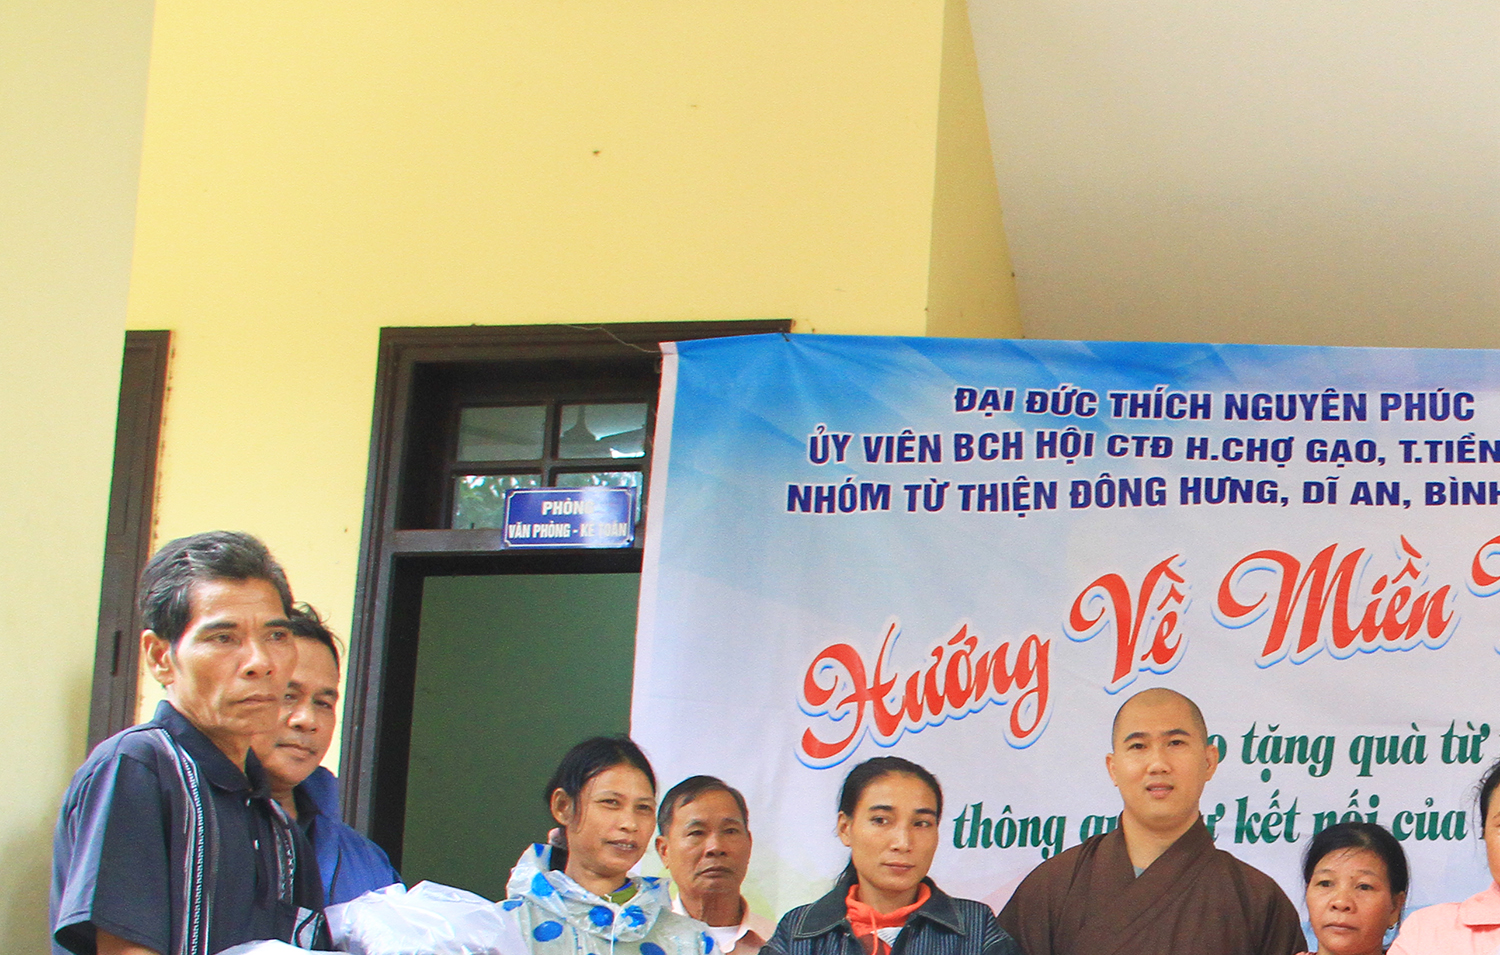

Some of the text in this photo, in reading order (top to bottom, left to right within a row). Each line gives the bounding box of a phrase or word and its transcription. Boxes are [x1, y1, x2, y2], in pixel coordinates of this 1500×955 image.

[953, 382, 1475, 421] ĐẠI ĐỨC THÍCH NGUYÊN PHÚC
[809, 424, 852, 465] ỦY
[863, 427, 941, 464] VIÊN
[953, 431, 1023, 461] BCH
[1036, 426, 1094, 466] HỘI
[1106, 434, 1174, 460] CTĐ
[1186, 435, 1295, 468] H.CHỢ
[1305, 438, 1385, 468] GẠO,
[542, 497, 596, 516] PHÒNG
[786, 477, 891, 514] NHÓM
[903, 477, 950, 512] TỪ
[958, 475, 1057, 519] THIỆN
[1069, 472, 1167, 508] ĐÔNG
[1180, 476, 1289, 507] HƯNG,
[1302, 476, 1338, 504] DĨ
[1350, 481, 1411, 509] AN,
[508, 521, 531, 539] VĂN
[532, 520, 571, 538] PHÒNG
[801, 623, 1051, 760] Hướng
[1069, 554, 1187, 684] Về
[1217, 534, 1454, 658] Miền
[1241, 721, 1333, 782] tặng
[1349, 721, 1433, 779] quà
[1441, 719, 1491, 764] từ
[953, 802, 1066, 859] thông
[1235, 789, 1301, 845] kết
[1392, 798, 1468, 841] của
